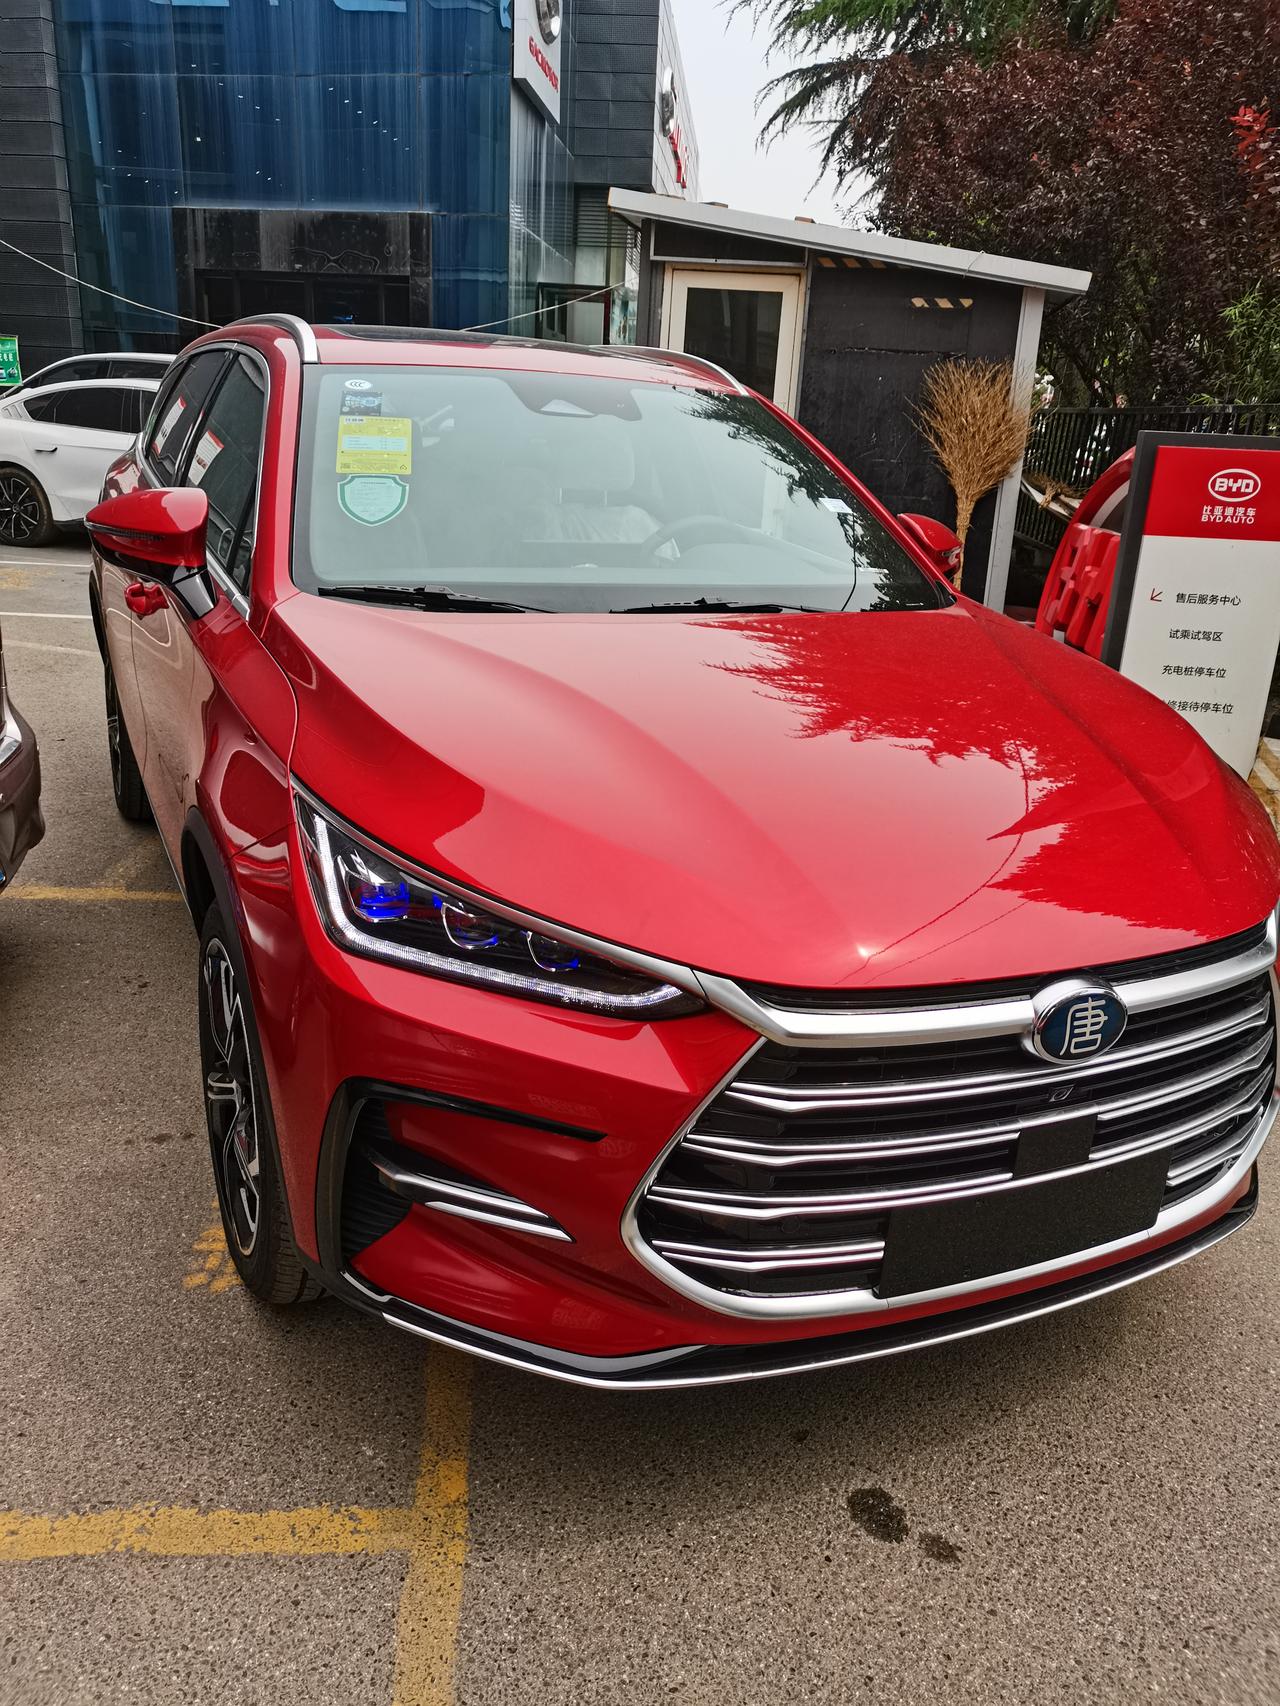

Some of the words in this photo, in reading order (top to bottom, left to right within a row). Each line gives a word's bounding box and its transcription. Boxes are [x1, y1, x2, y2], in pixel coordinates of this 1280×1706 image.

[1214, 477, 1255, 493] BYD
[1202, 505, 1257, 517] 比亚迪汽车
[1201, 514, 1224, 523] BYD
[1224, 515, 1255, 525] AUTO
[1176, 592, 1241, 606] 售后服务中心
[1169, 628, 1223, 642] 试乘试驾区
[1162, 664, 1227, 679] 充电桩停车位
[1161, 699, 1234, 714] 修接待停车位
[1059, 996, 1109, 1056] 唐
